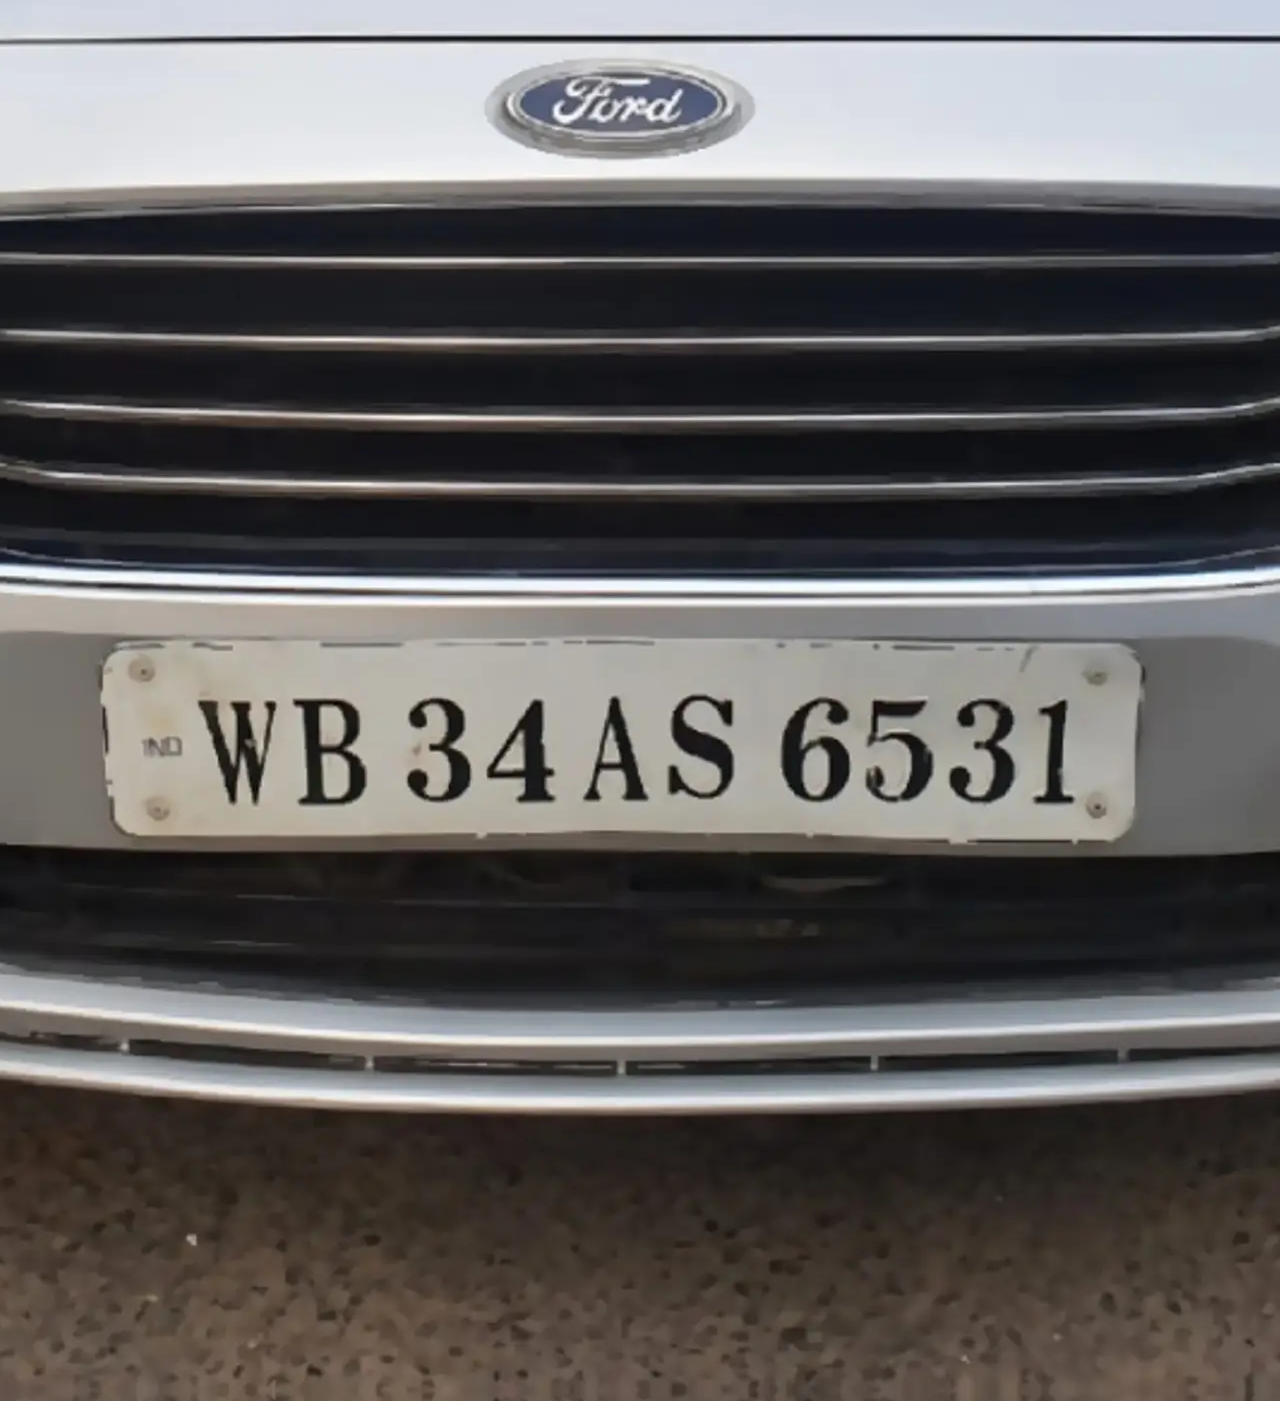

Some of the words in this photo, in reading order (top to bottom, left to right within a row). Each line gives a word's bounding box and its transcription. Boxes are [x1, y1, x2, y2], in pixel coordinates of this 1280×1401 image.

[551, 74, 685, 125] Ford
[196, 696, 368, 807] WB
[779, 696, 1077, 805] 6531
